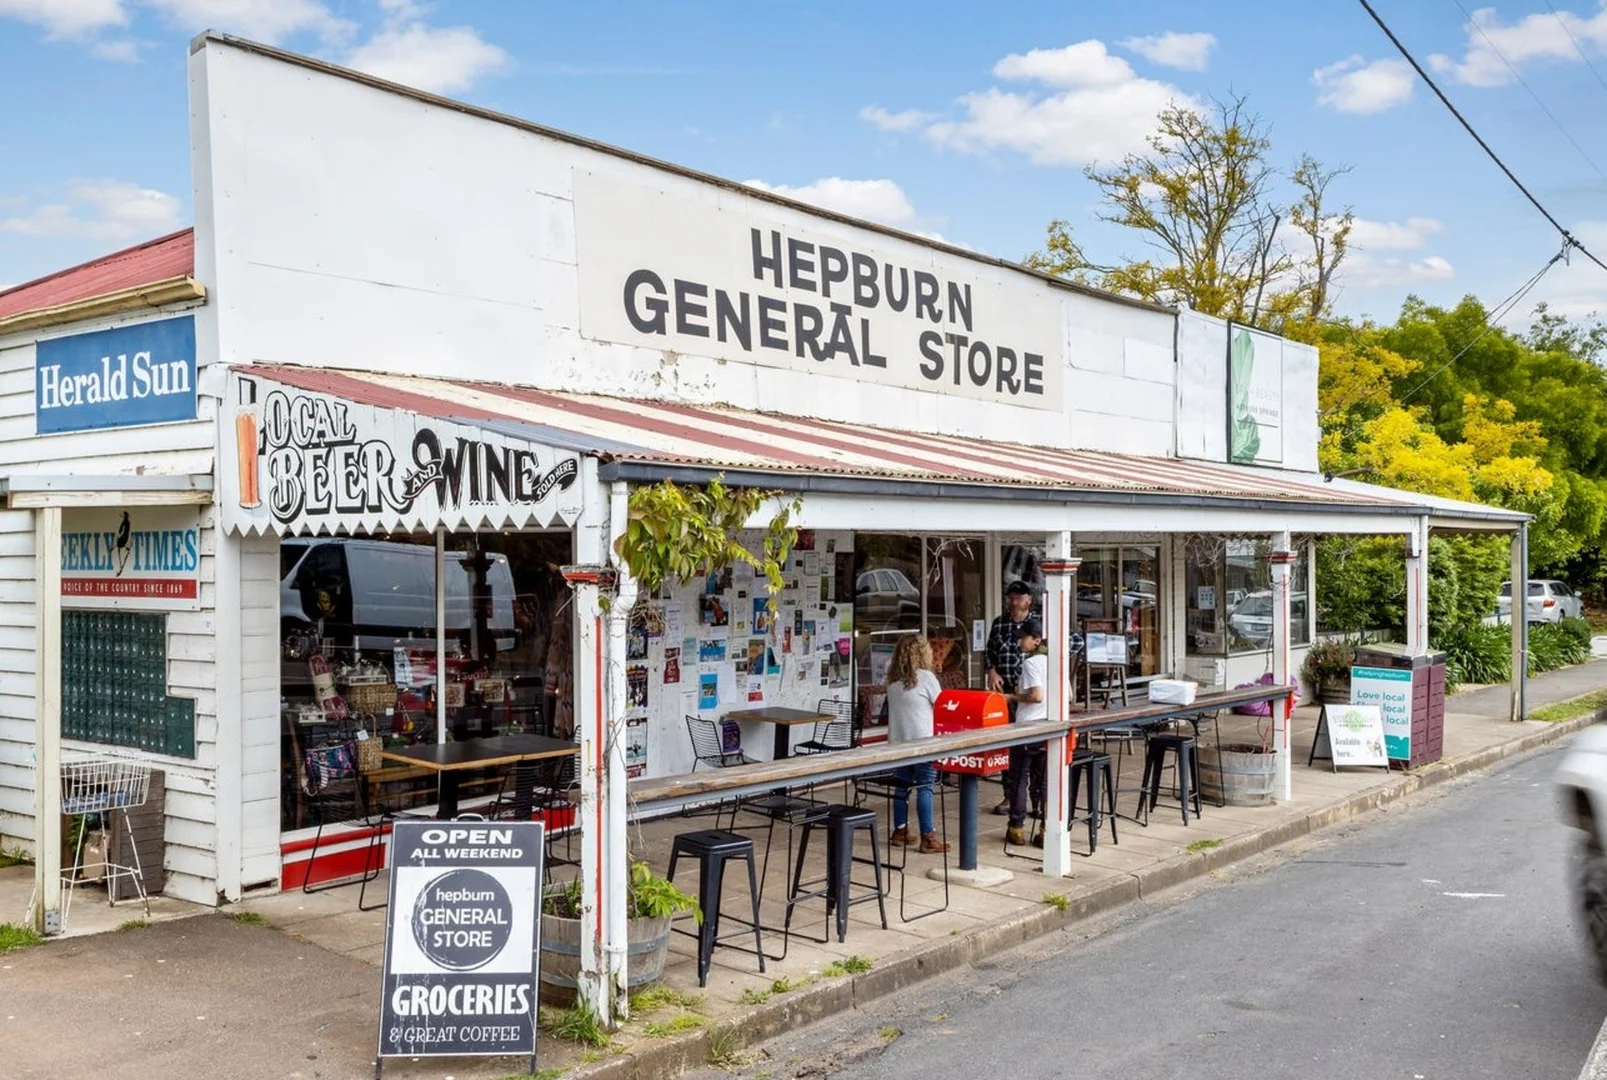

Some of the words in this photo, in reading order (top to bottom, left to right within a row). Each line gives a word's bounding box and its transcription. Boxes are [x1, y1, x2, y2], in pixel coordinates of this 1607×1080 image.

[750, 227, 973, 332] HEPBURN
[623, 269, 887, 368] GENERAL
[919, 330, 1043, 395] STORE
[40, 354, 128, 409] Herald
[132, 351, 191, 398] Sun
[238, 376, 357, 455] LOCAL
[411, 463, 437, 493] AND
[412, 428, 539, 512] WINE
[268, 439, 414, 525] BEER
[536, 475, 556, 499] SOLD
[555, 460, 575, 480] HERE
[131, 529, 197, 571] TIMES
[63, 582, 81, 592] VOICE
[84, 583, 93, 592] OF
[96, 583, 108, 592] THE
[112, 583, 140, 593] COUNTRY
[143, 584, 163, 593] SINCE
[166, 584, 183, 594] 1869
[1357, 690, 1380, 700] Love
[1383, 692, 1405, 702] local
[1383, 704, 1405, 714] local
[1386, 715, 1409, 725] local
[950, 755, 984, 768] POST
[421, 829, 513, 845] OPEN
[410, 848, 441, 859] ALL
[444, 848, 523, 859] WEEKEND
[436, 888, 495, 904] hepburn
[420, 908, 508, 925] GENERAL
[433, 930, 493, 948] STORE
[391, 984, 530, 1016] GROCERIES
[389, 1026, 400, 1043] &
[404, 1026, 456, 1043] GREAT
[460, 1026, 520, 1042] COFFEE
